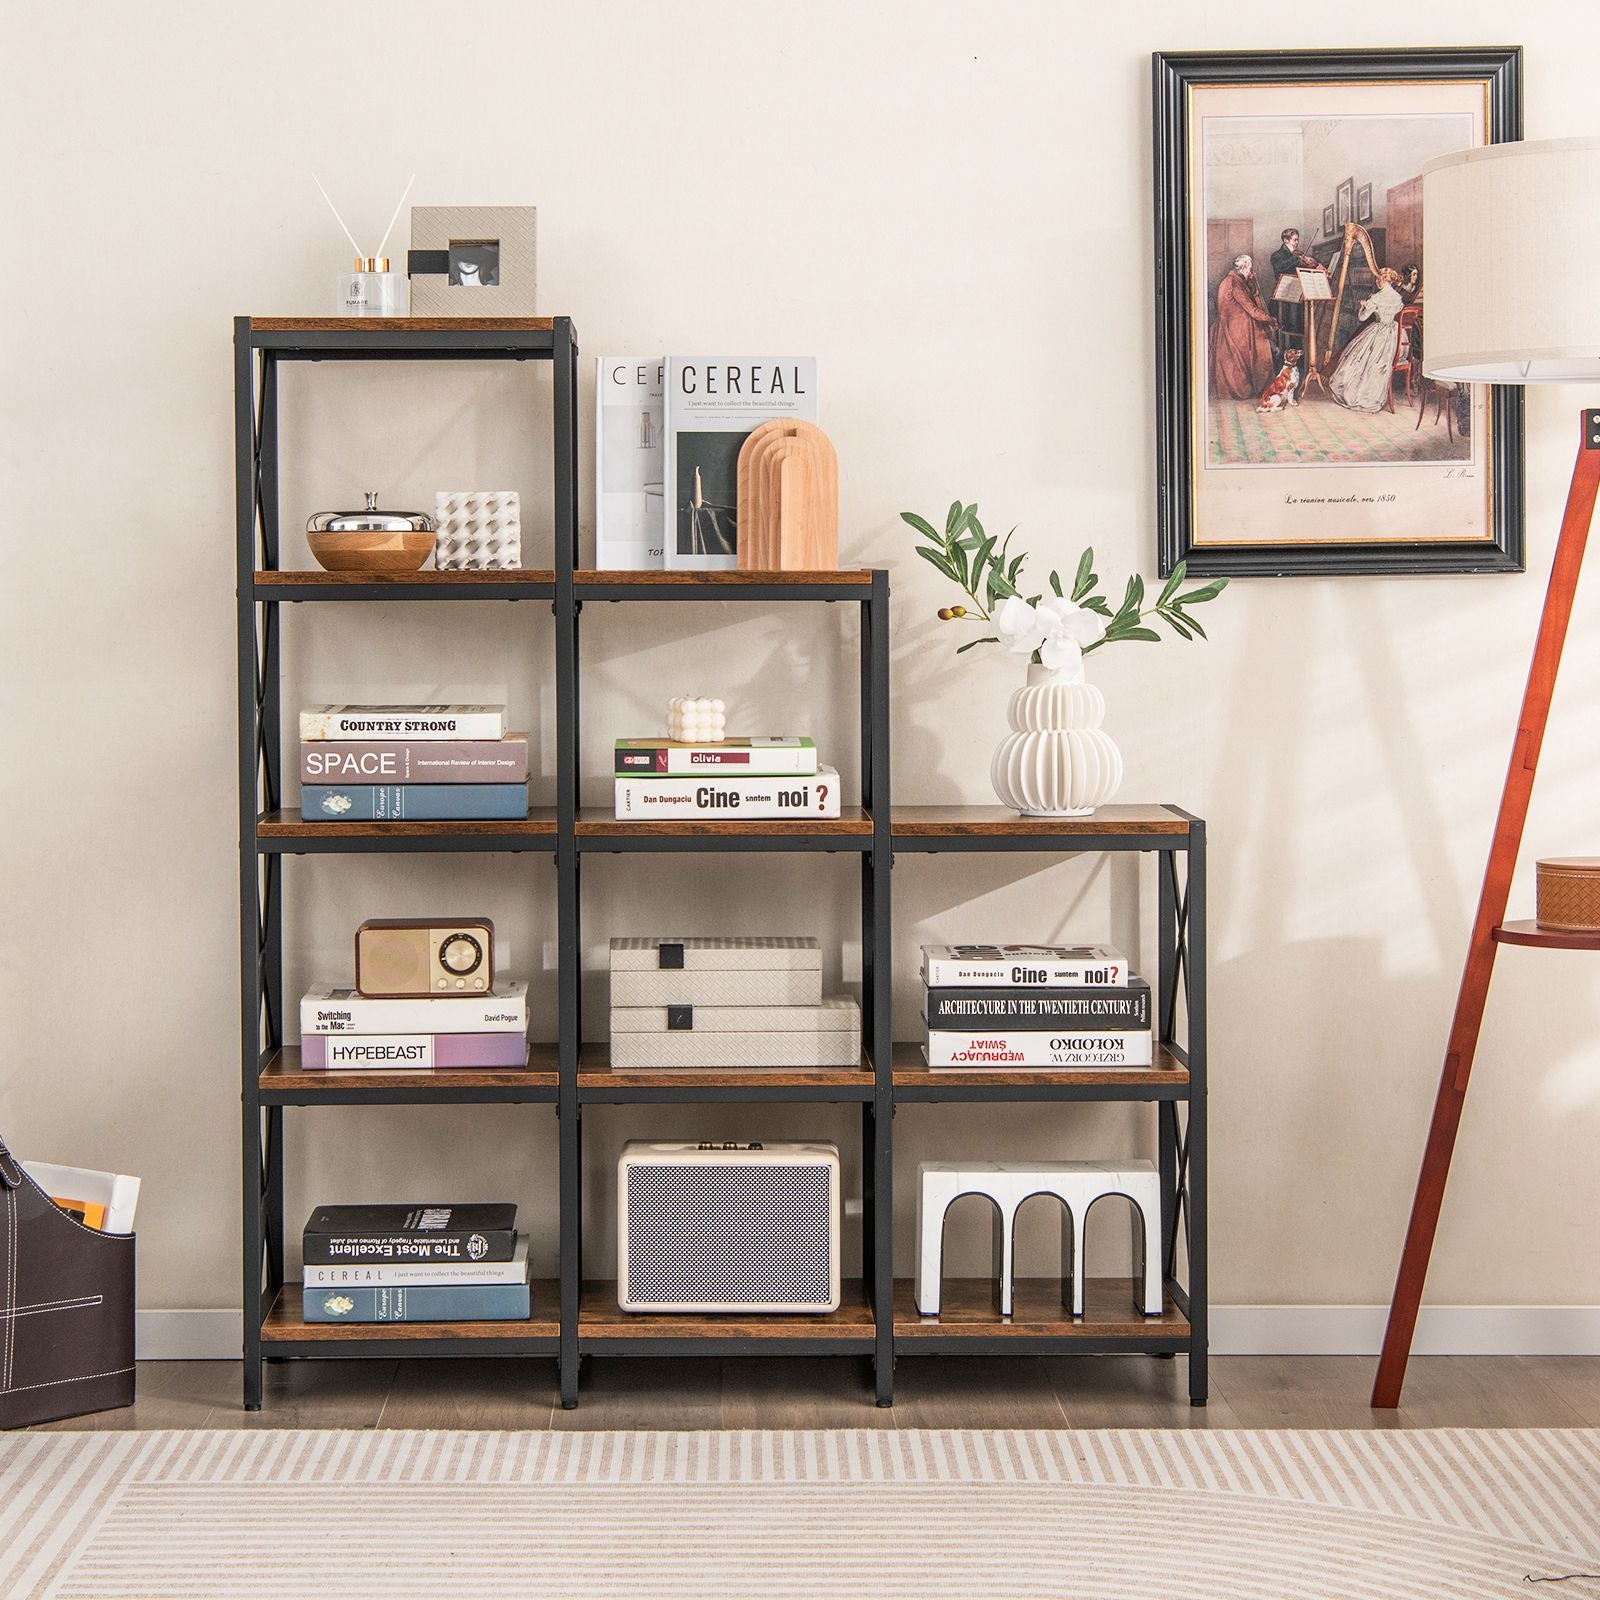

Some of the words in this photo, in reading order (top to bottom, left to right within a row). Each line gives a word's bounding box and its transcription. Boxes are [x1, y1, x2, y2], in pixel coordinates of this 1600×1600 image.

[682, 365, 805, 394] CEREAL
[1376, 494, 1397, 503] 1850
[340, 719, 402, 731] COUNTRY
[404, 720, 457, 731] STRONG
[306, 752, 397, 774] SPACE
[692, 754, 721, 762] olivia
[376, 787, 386, 819] Europe
[392, 786, 401, 819] Canvas
[644, 795, 658, 803] Dan
[659, 795, 692, 805] Dungaciu
[696, 787, 740, 808] Cine
[778, 786, 808, 808] noi
[815, 784, 828, 811] ?
[1011, 966, 1048, 984] Cine
[1007, 1000, 1018, 1014] IN
[1018, 1000, 1036, 1014] THE
[1038, 1000, 1090, 1014] TWENTIETH
[1090, 1000, 1132, 1015] CENTURY
[317, 1010, 352, 1021] Switching
[484, 1014, 500, 1022] David
[500, 1014, 518, 1023] Pogue
[330, 1020, 345, 1030] Mac
[969, 1040, 1007, 1050] ŚWIAT
[1050, 1038, 1124, 1050] KOŁODKO
[333, 1046, 426, 1060] HYPEBEAST
[951, 1050, 1024, 1062] WĘDRUJĄCY
[1050, 1053, 1064, 1063] W.
[1065, 1053, 1125, 1063] GRZEGORZ
[330, 1244, 392, 1256] Excellent
[397, 1244, 430, 1256] Most
[434, 1244, 460, 1256] The
[318, 1271, 382, 1280] CEREAL
[378, 1288, 388, 1320] Europe
[394, 1287, 402, 1320] Canvas
